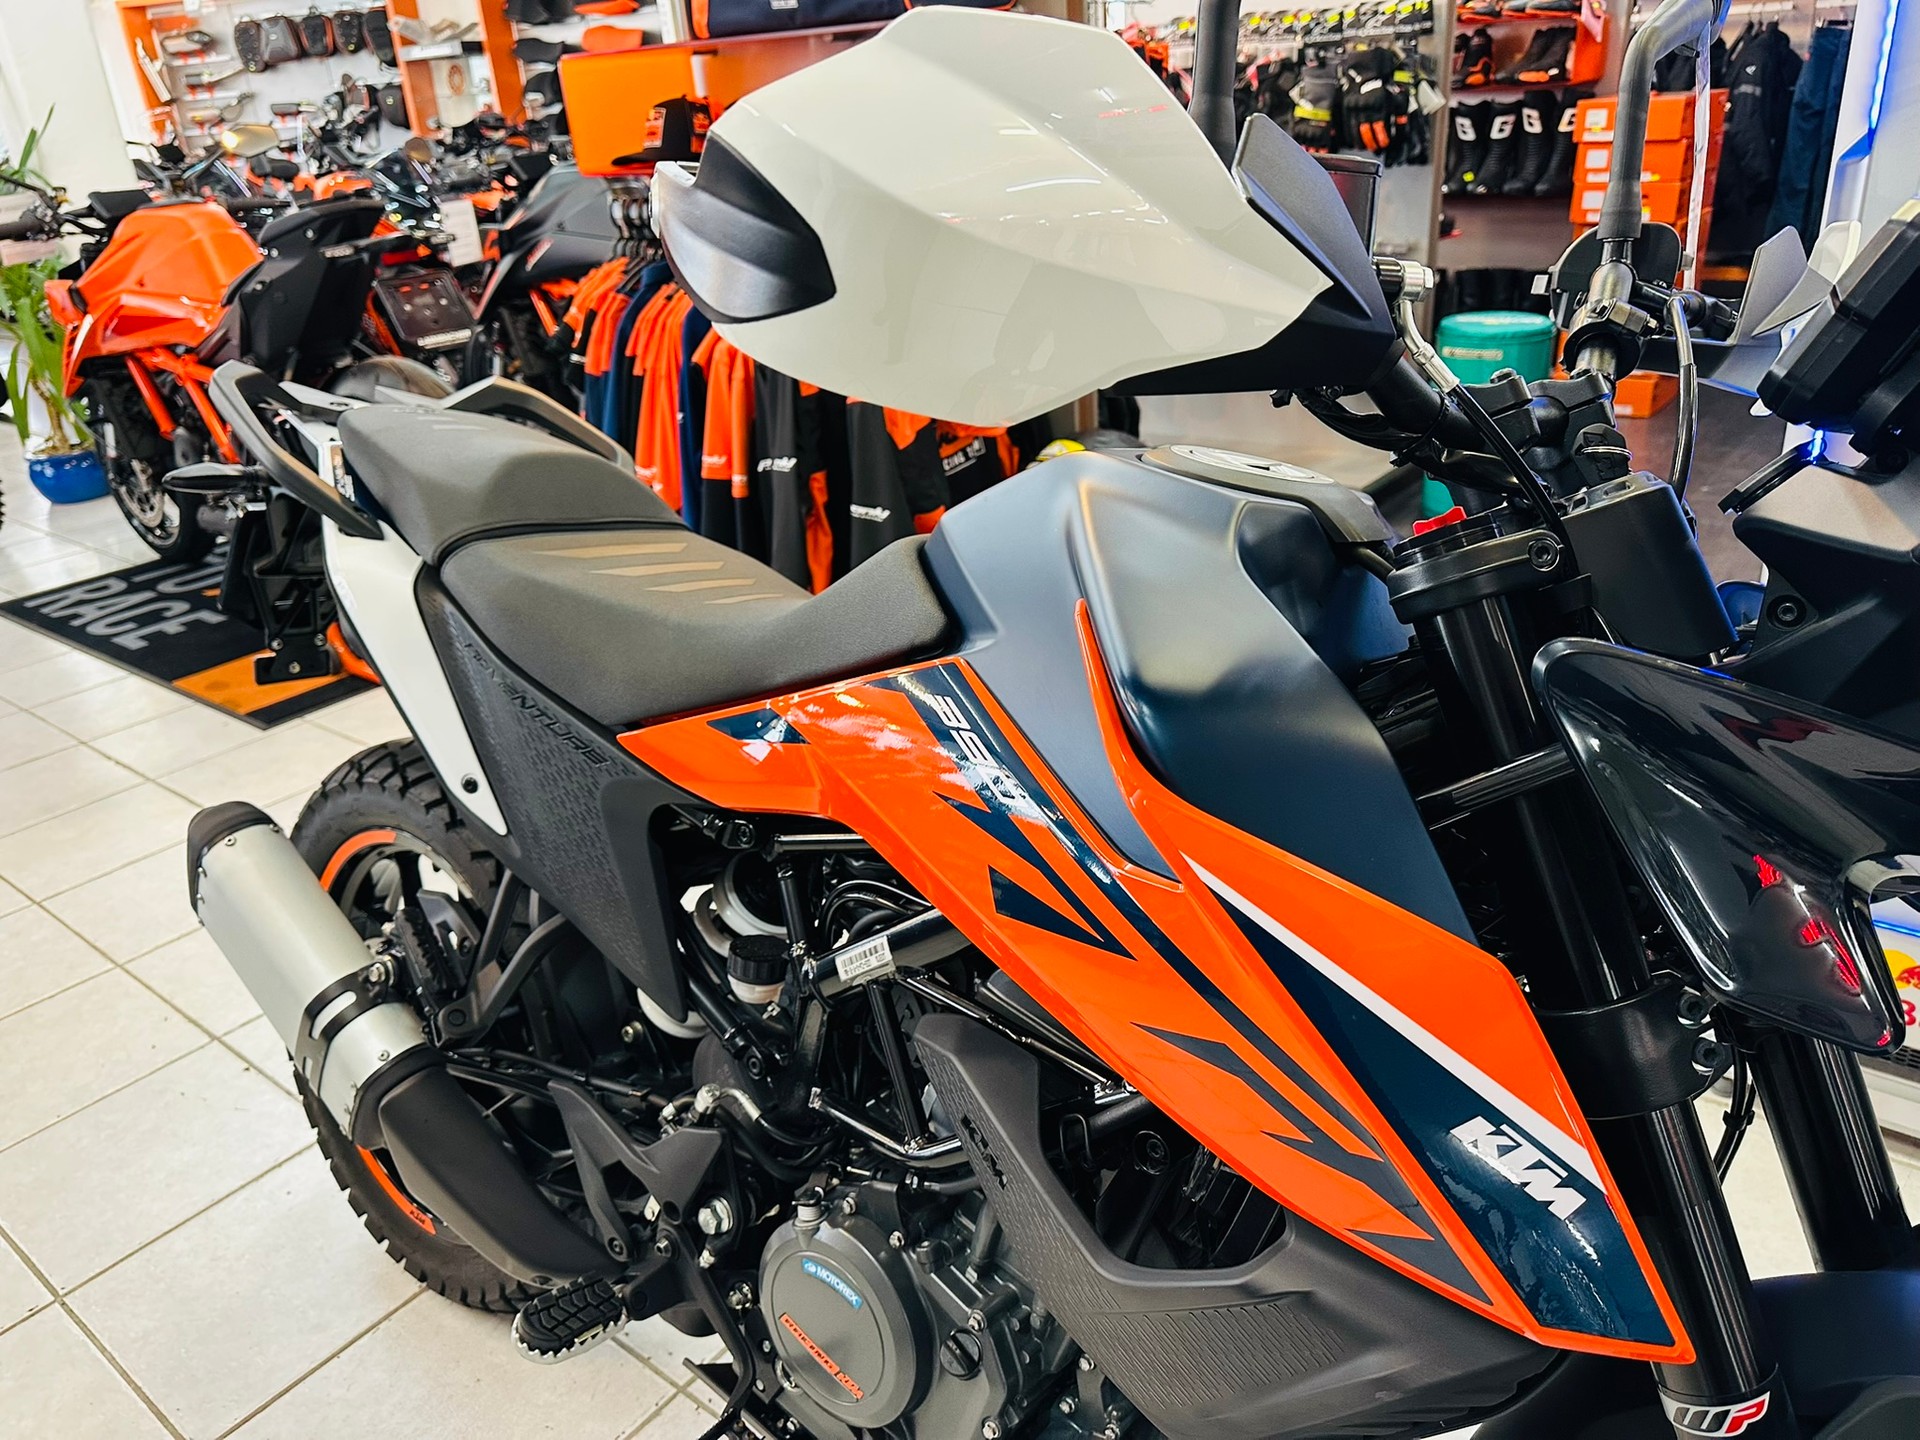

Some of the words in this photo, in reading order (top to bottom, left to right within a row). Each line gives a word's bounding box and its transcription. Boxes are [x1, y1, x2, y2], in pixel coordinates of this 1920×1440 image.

[24, 576, 229, 650] RACE
[464, 642, 611, 767] ADVENTURE
[931, 694, 1030, 807] 390
[1450, 1115, 1587, 1220] KTM
[816, 1265, 859, 1305] MOTOREX
[1672, 1399, 1766, 1433] WP
